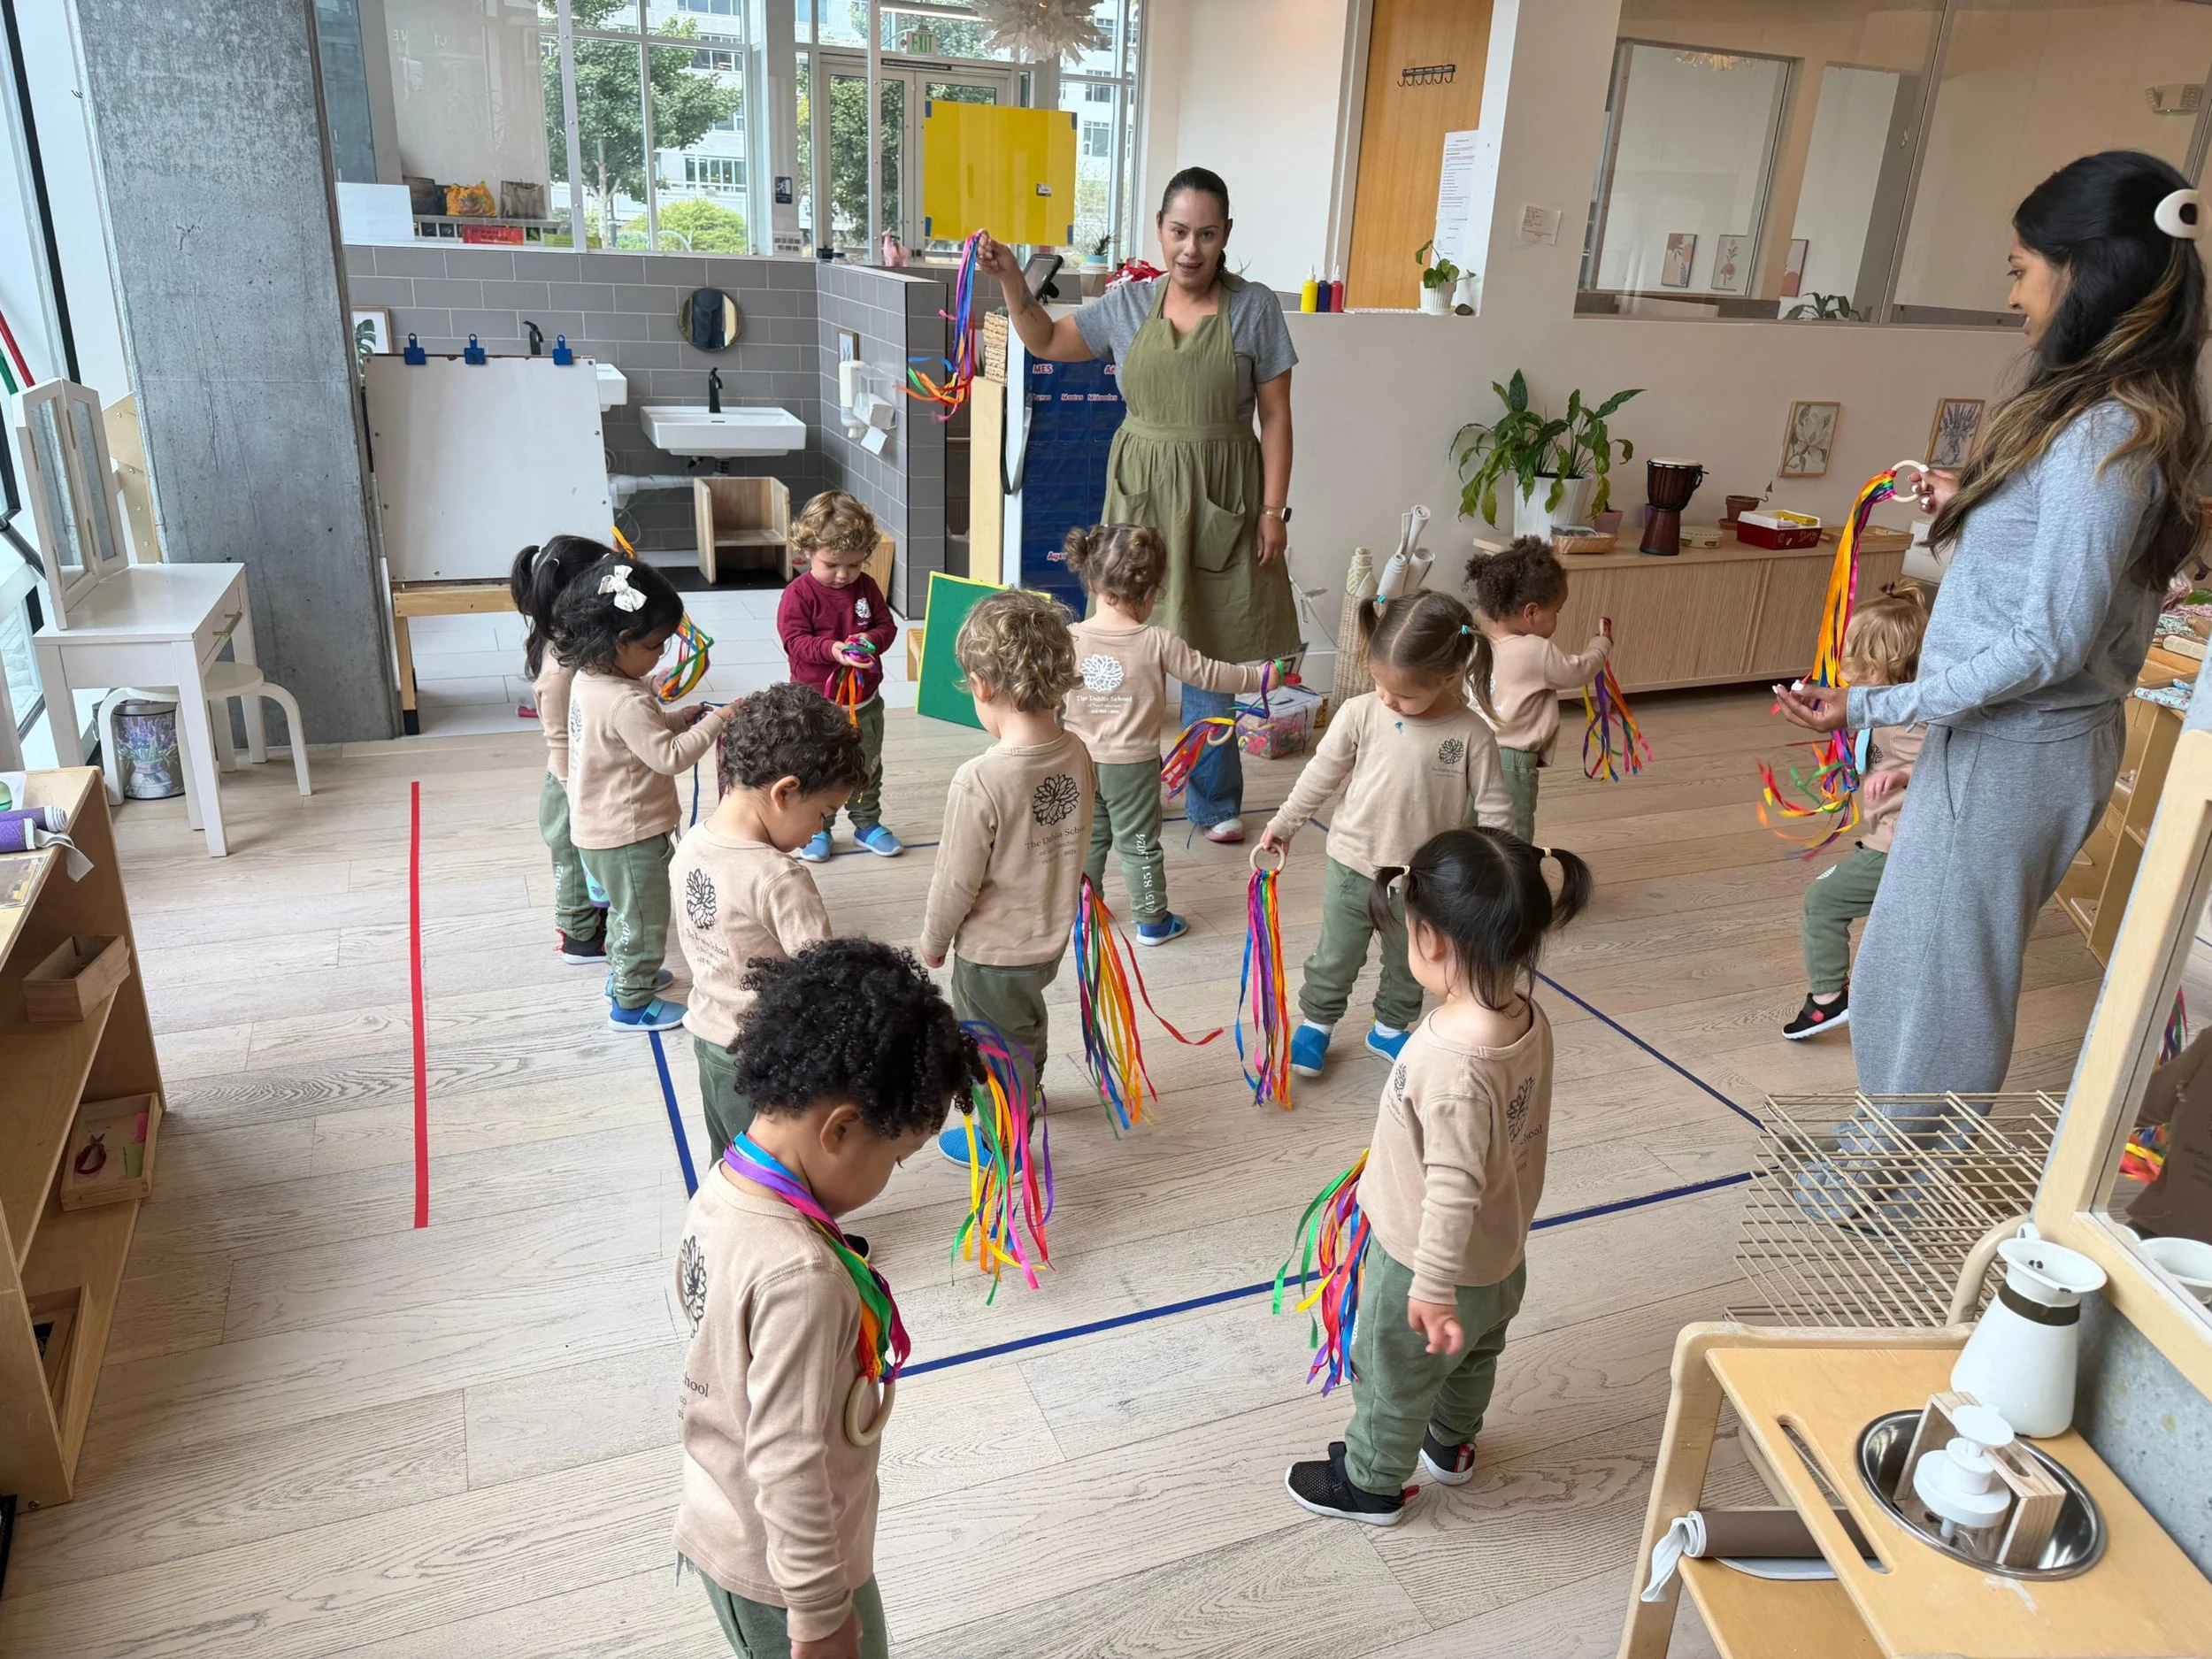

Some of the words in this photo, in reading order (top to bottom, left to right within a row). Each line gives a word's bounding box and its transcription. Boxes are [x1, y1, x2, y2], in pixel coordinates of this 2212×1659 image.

[911, 33, 933, 54] EXIT
[1033, 364, 1053, 374] MES
[1141, 864, 1153, 888] 851
[683, 1371, 709, 1398] hool
